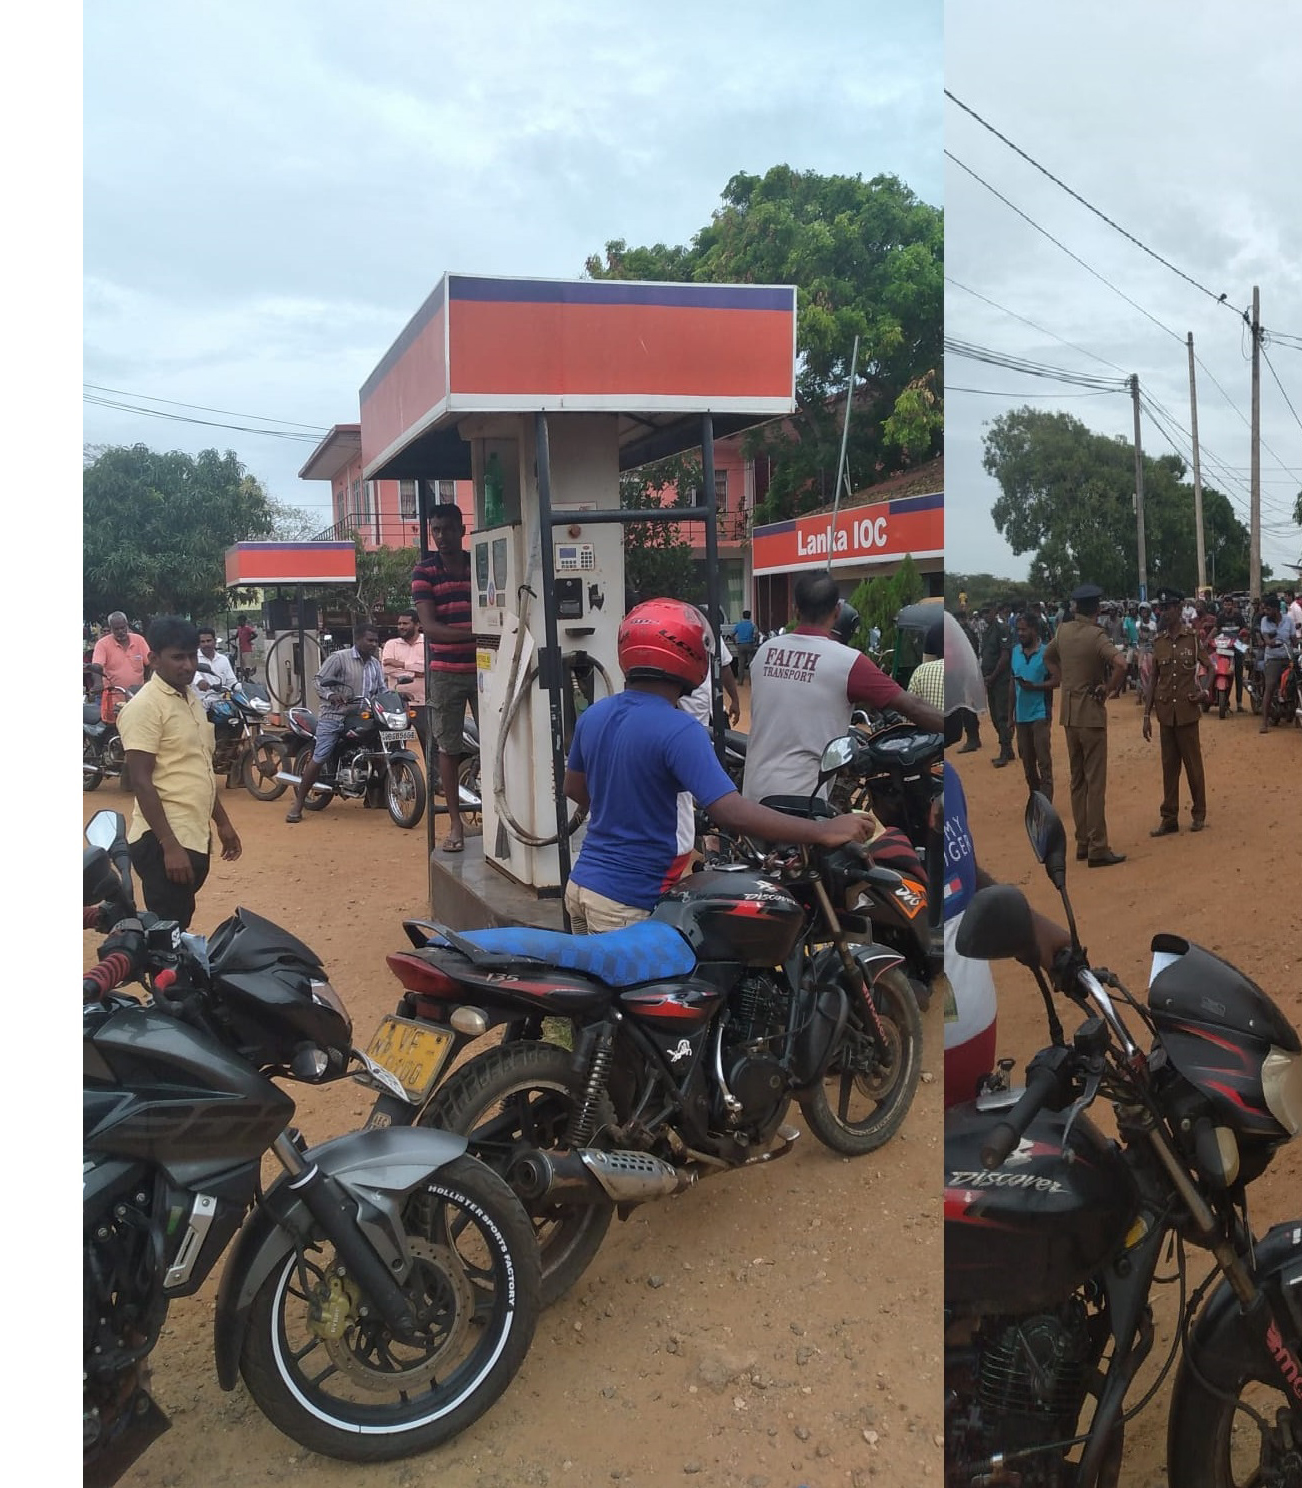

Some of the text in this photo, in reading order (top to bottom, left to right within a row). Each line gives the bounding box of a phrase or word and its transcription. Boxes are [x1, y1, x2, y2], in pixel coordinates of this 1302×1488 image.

[796, 517, 888, 556] Lanka IOC
[765, 647, 821, 671] FAITH
[763, 666, 815, 683] TRANSPORT
[948, 1168, 1071, 1193] Discover
[428, 1185, 515, 1307] HOLLISTER SPORTS FACTORY
